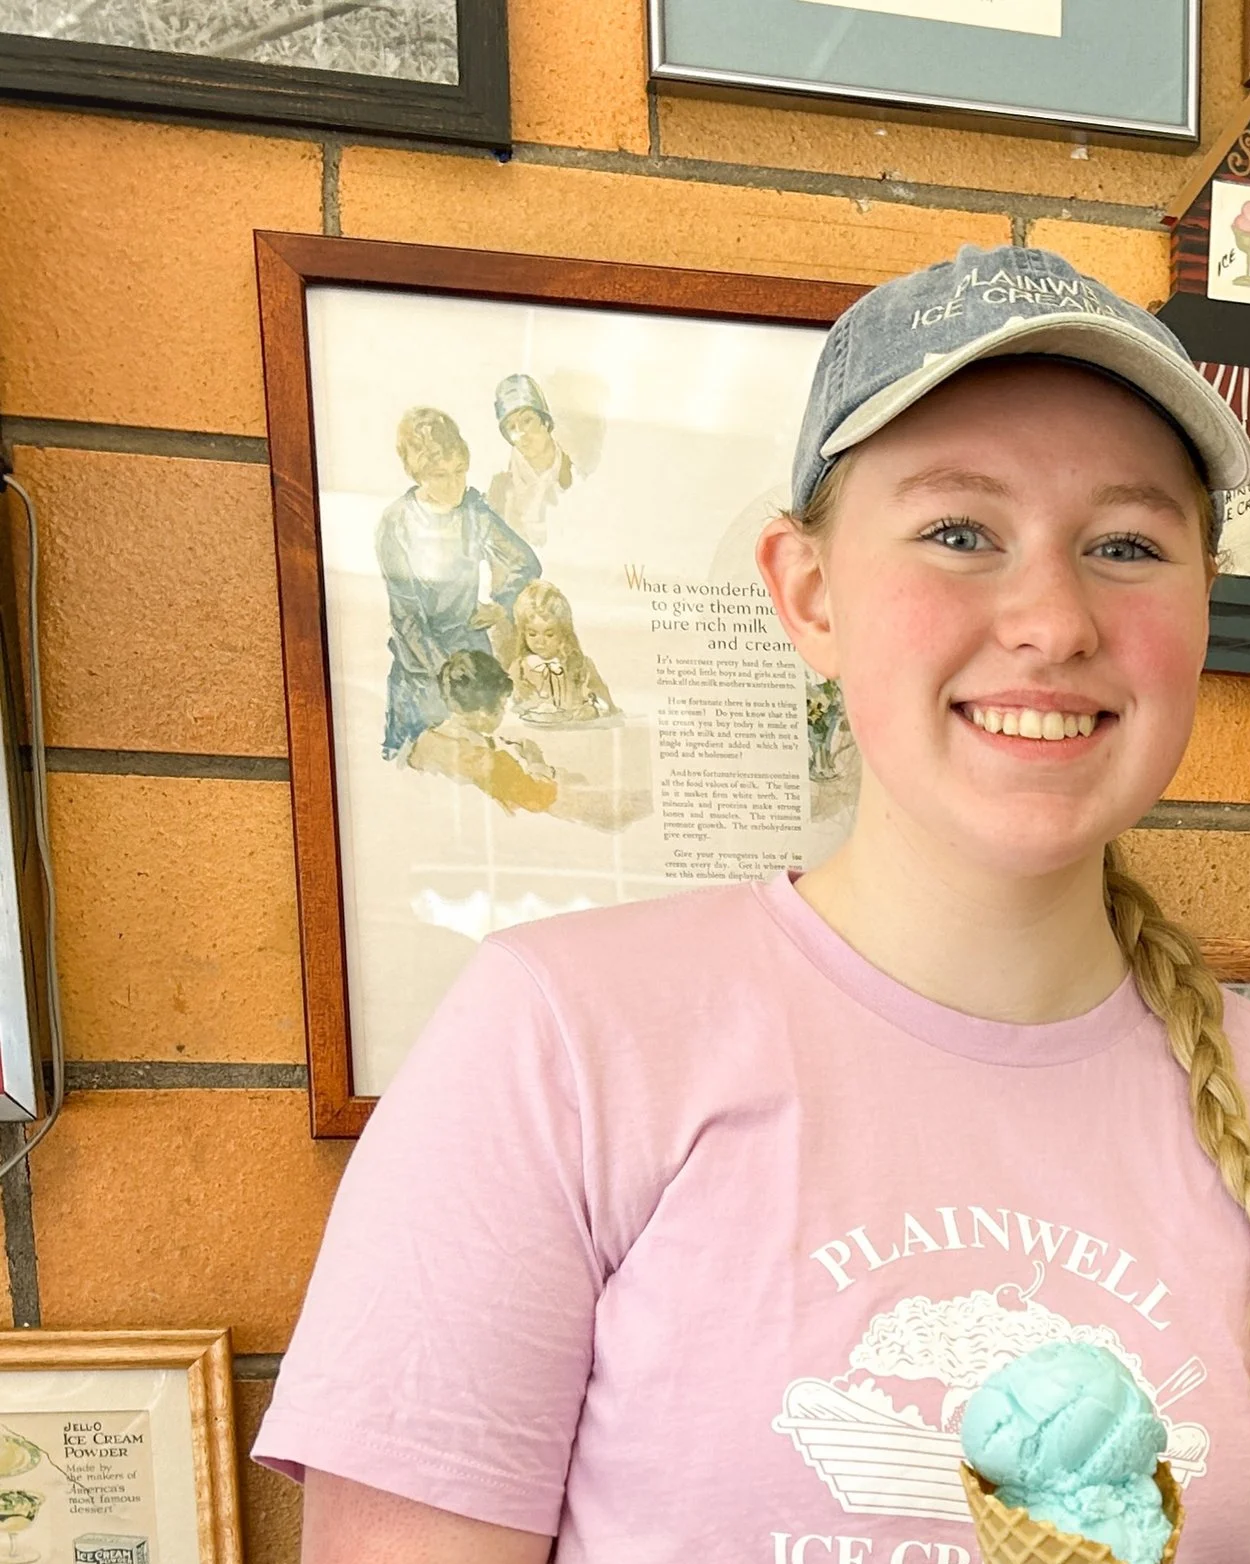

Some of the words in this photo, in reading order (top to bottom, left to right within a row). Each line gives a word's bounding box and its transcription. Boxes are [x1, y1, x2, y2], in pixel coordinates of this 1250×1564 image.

[1218, 248, 1236, 276] ICE
[911, 300, 964, 330] ICE
[624, 564, 667, 593] What
[673, 584, 681, 594] a
[652, 600, 667, 611] to
[673, 598, 704, 617] give
[710, 600, 751, 615] them
[755, 604, 778, 615] mo
[651, 619, 689, 632] pure
[696, 617, 726, 631] rich
[733, 618, 767, 633] milk
[708, 636, 737, 650] and
[810, 1205, 1174, 1331] PLAINWELL
[64, 1433, 86, 1445] ICE
[93, 1433, 144, 1445] CREAM
[65, 1447, 128, 1458] POWDER
[67, 1464, 95, 1472] Made
[100, 1463, 112, 1471] by
[87, 1472, 124, 1480] makers
[127, 1470, 137, 1479] of
[69, 1496, 95, 1504] most
[100, 1494, 141, 1503] famous
[70, 1505, 112, 1513] dessert
